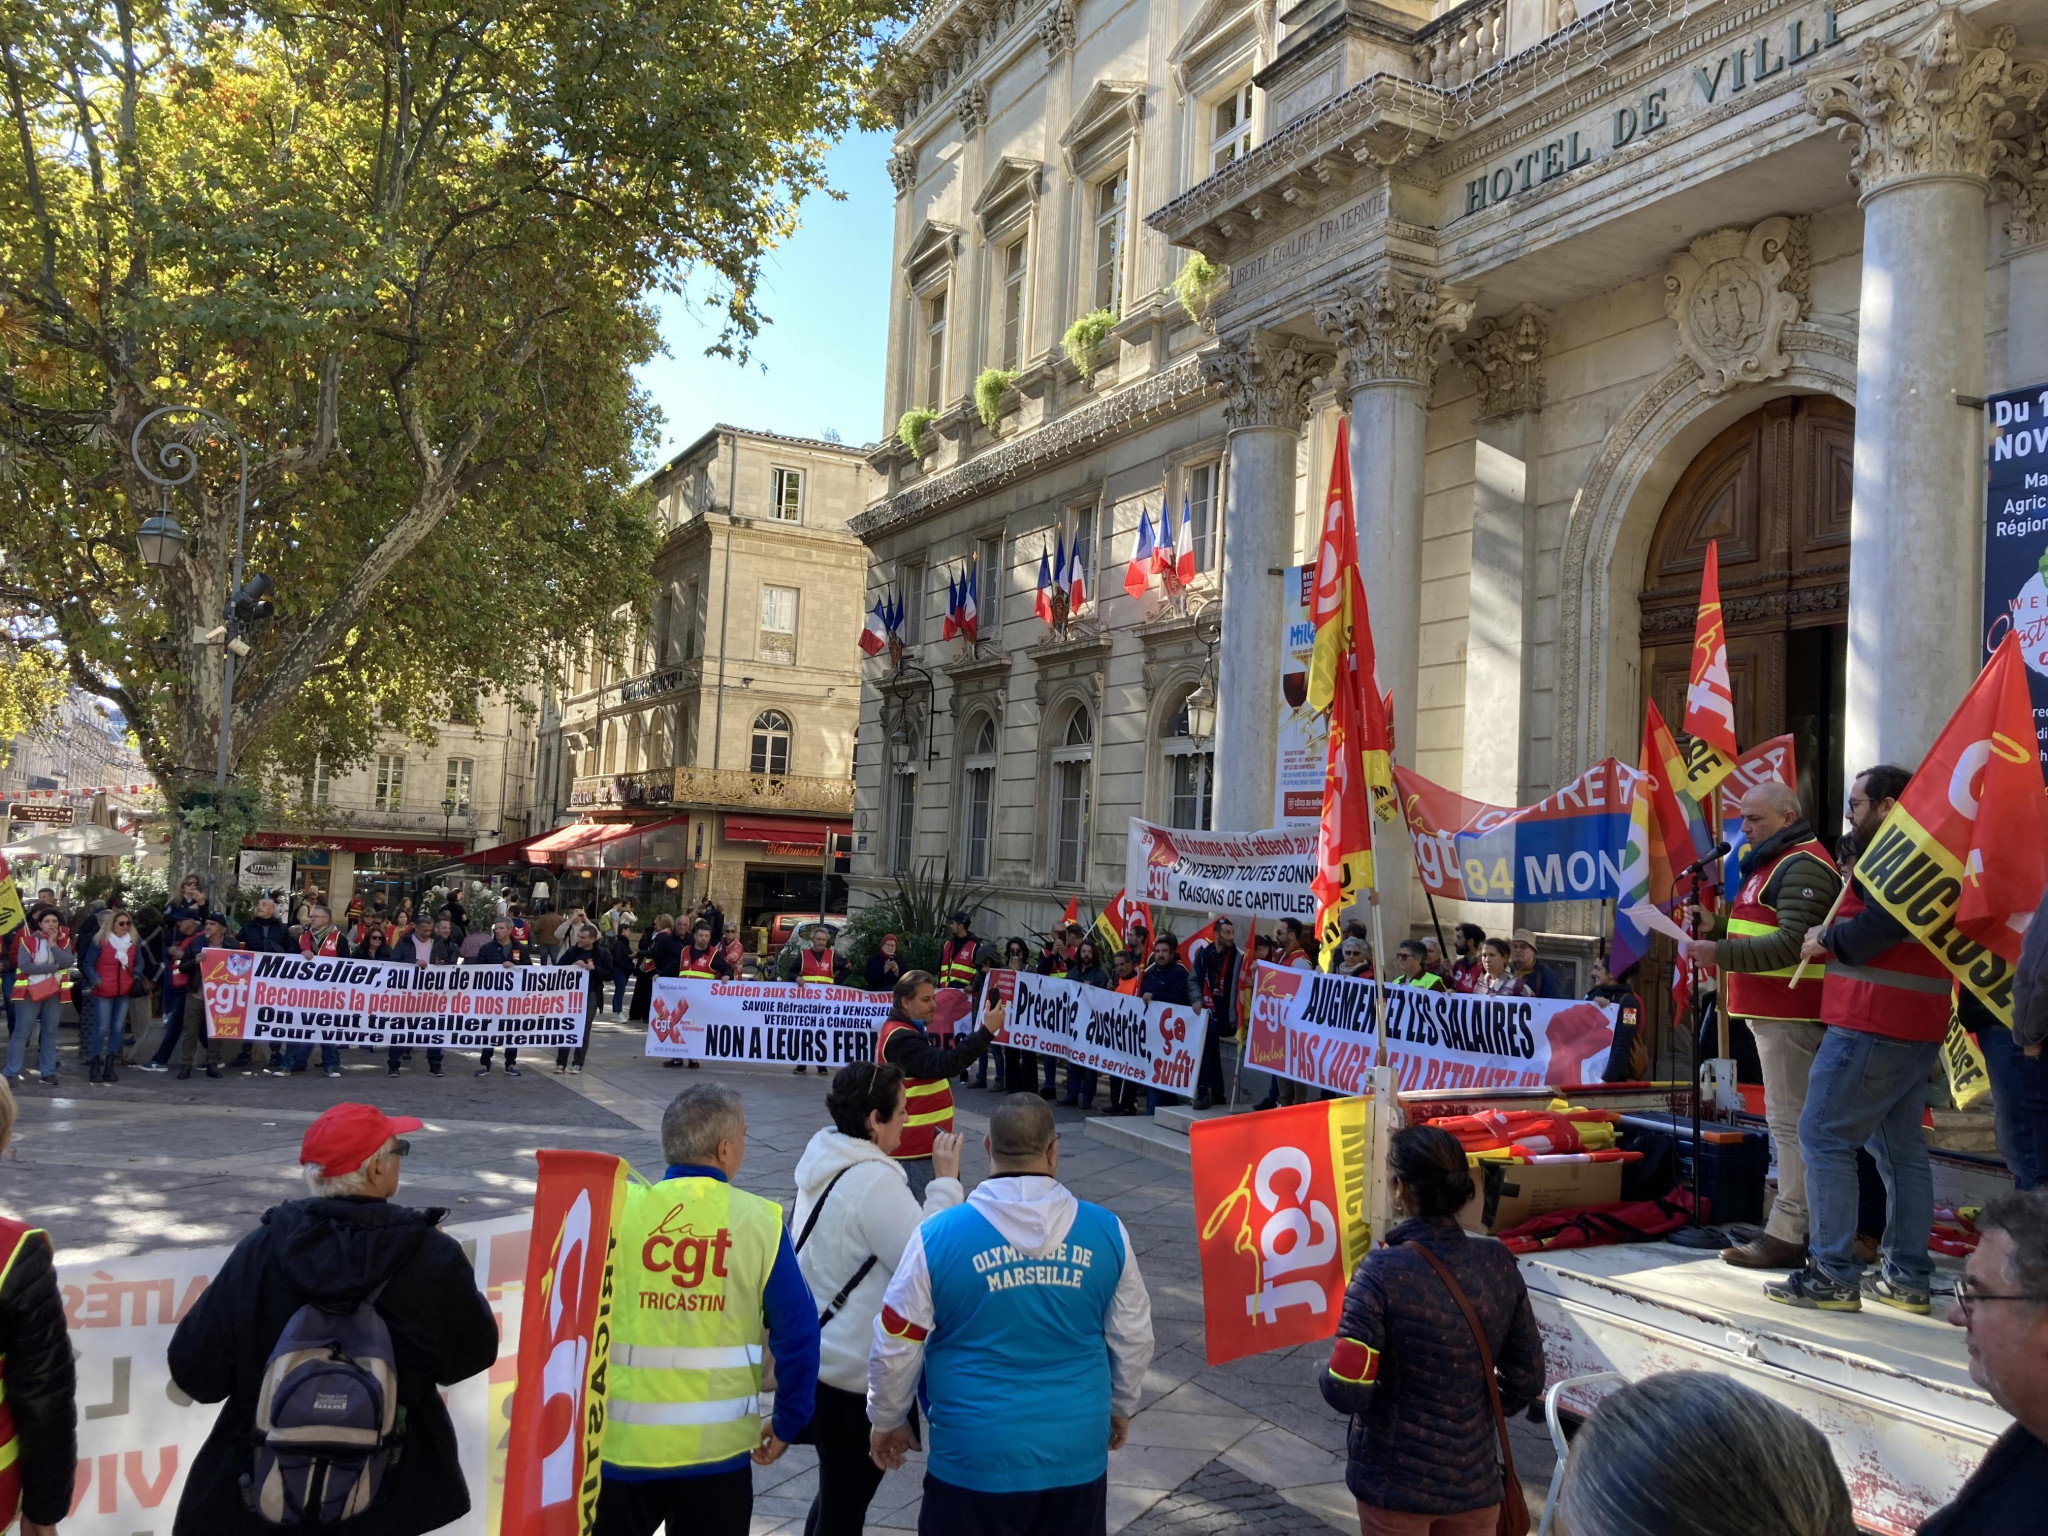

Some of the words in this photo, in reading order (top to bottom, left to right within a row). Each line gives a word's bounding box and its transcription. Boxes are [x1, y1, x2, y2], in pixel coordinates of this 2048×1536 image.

[1466, 131, 1591, 216] HOTEL
[1612, 88, 1667, 149] DE
[1995, 400, 2029, 427] Du
[766, 842, 822, 857] Restaurant
[1149, 842, 1176, 866] la
[1167, 832, 1191, 854] Tout
[1186, 834, 1225, 857] homme
[1224, 837, 1245, 862] qui
[1294, 836, 1310, 855] au
[1173, 856, 1235, 880] S'INTERDIT
[1236, 865, 1278, 881] TOUTES
[1465, 857, 1514, 896] 84
[1227, 890, 1243, 907] DE
[1245, 891, 1315, 914] CAPITULER
[204, 961, 247, 984] la
[254, 954, 382, 988] Muselier,
[387, 968, 408, 989] au
[412, 966, 446, 990] lieu
[449, 967, 469, 990] de
[473, 970, 514, 991] nous
[521, 968, 582, 991] Insulter
[1258, 970, 1293, 998] la
[203, 979, 247, 1013] cgt
[254, 981, 345, 1010] Reconnais
[349, 988, 365, 1012] la
[368, 990, 447, 1014] pénibilité
[451, 991, 471, 1014] de
[474, 995, 503, 1015] nos
[507, 993, 564, 1015] métiers
[568, 991, 583, 1014] !!!
[711, 983, 760, 997] Soutien
[763, 987, 786, 998] aux
[789, 987, 821, 999] sites
[257, 1007, 293, 1025] On
[301, 1011, 361, 1028] veut
[368, 1014, 492, 1031] travailler
[498, 1015, 575, 1032] moins
[742, 1000, 775, 1012] SAVOIE
[777, 1001, 831, 1015] Réfractaire
[834, 1004, 840, 1015] à
[1015, 978, 1082, 1042] Précarité,
[1086, 997, 1151, 1064] austérité,
[1253, 993, 1294, 1032] cgt
[215, 1024, 238, 1037] ACA
[254, 1023, 315, 1040] Pour
[321, 1029, 384, 1043] vivre
[391, 1032, 444, 1045] plus
[451, 1032, 578, 1046] longtemps
[655, 1016, 671, 1033] cgt
[764, 1014, 816, 1027] VETROTECH
[819, 1016, 824, 1027] à
[827, 1017, 872, 1029] CONDREN
[1159, 1007, 1185, 1056] Ça
[1406, 991, 1438, 1046] LES
[1436, 996, 1535, 1059] SALAIRES
[705, 1024, 744, 1058] NON
[749, 1026, 762, 1059] A
[767, 1027, 827, 1062] LEURS
[1013, 1032, 1037, 1049] CGT
[1088, 1054, 1099, 1067] et
[1101, 1060, 1146, 1080] services
[1290, 1030, 1320, 1082] PAS
[1318, 1038, 1371, 1093] L'AGE
[648, 1203, 732, 1238] la
[641, 1228, 732, 1288] cgt
[1071, 1245, 1093, 1268] DE
[986, 1266, 1083, 1292] MARSEILLE
[639, 1291, 726, 1312] TRICASTIN
